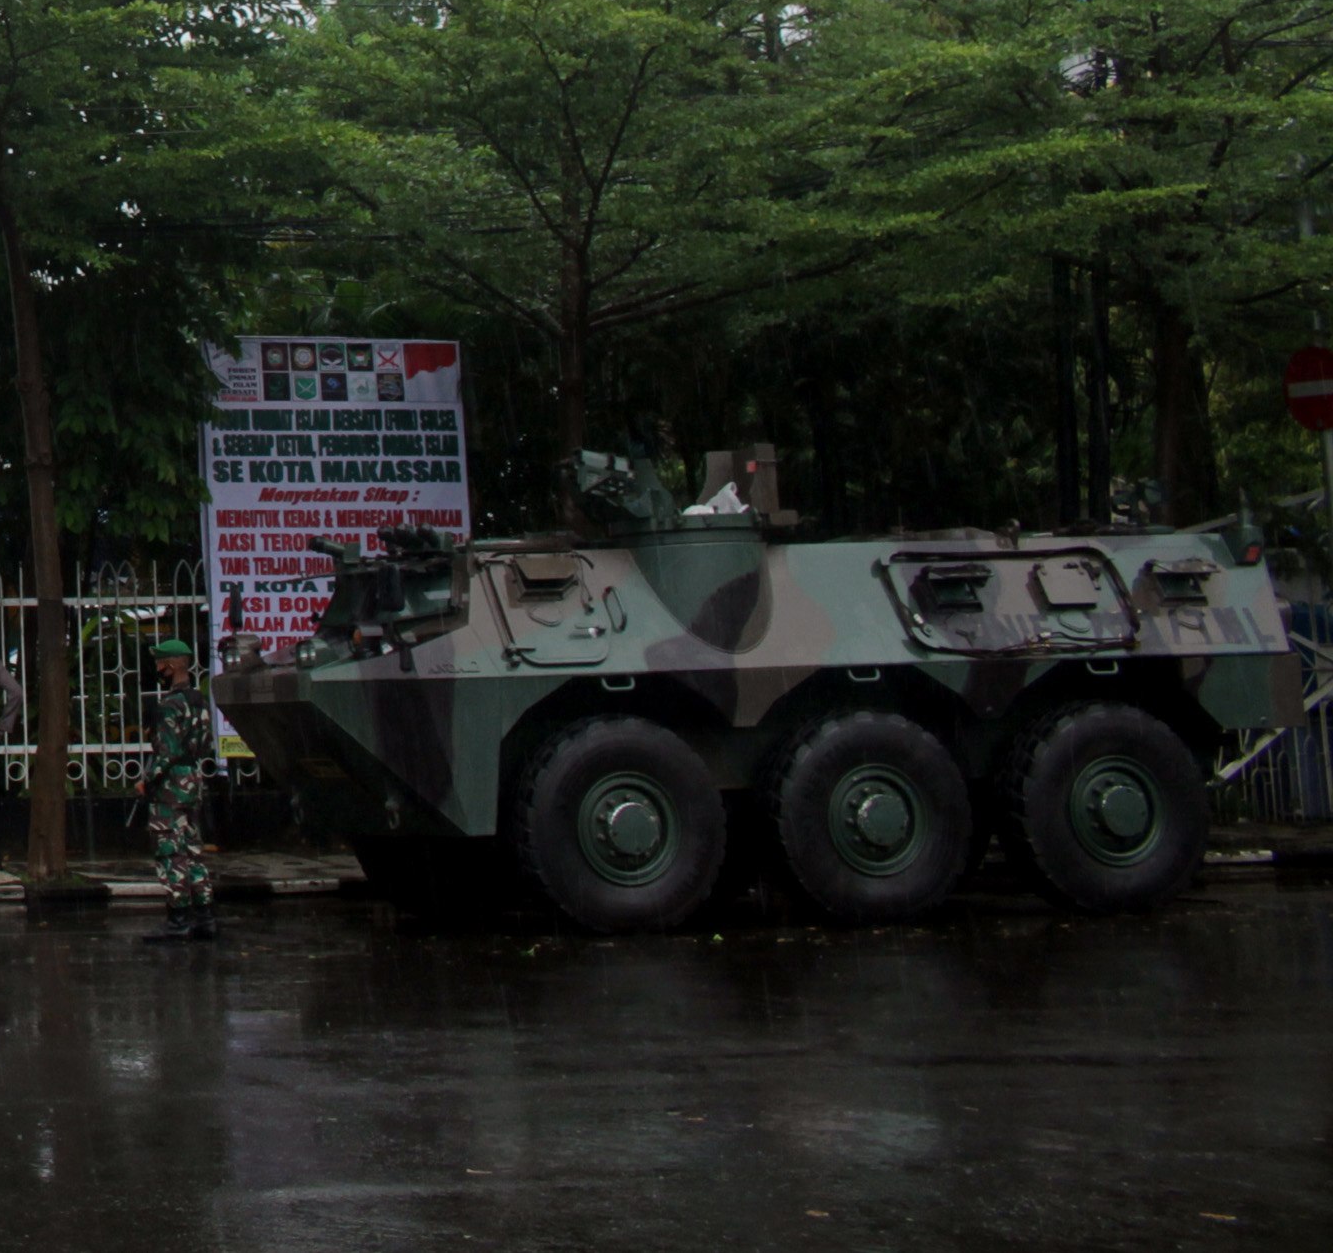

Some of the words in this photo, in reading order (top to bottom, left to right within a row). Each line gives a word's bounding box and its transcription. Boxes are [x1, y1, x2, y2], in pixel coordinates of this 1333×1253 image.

[296, 409, 331, 431] ISLAM
[333, 409, 382, 431] BERSATU
[223, 434, 274, 457] SEGENAP
[318, 434, 380, 457] PENGURUS
[425, 434, 459, 457] ISLAM
[212, 460, 244, 483] SE
[249, 460, 316, 483] KOTA
[321, 460, 462, 483] MAKASSAR
[258, 487, 360, 505] Menyatakan
[363, 487, 410, 505] Sikap
[216, 509, 281, 527] MENGUTUK
[283, 509, 321, 527] KERAS
[324, 509, 334, 527] &
[337, 509, 404, 527] MENGECAM
[406, 509, 464, 527] TINDAKAN
[218, 533, 257, 551] AKSI
[220, 558, 250, 575] YANG
[220, 581, 244, 592] DI
[254, 580, 319, 593] KOTA
[222, 597, 271, 613] AKSI
[279, 597, 331, 613] BOM
[222, 616, 285, 632] AALAH
